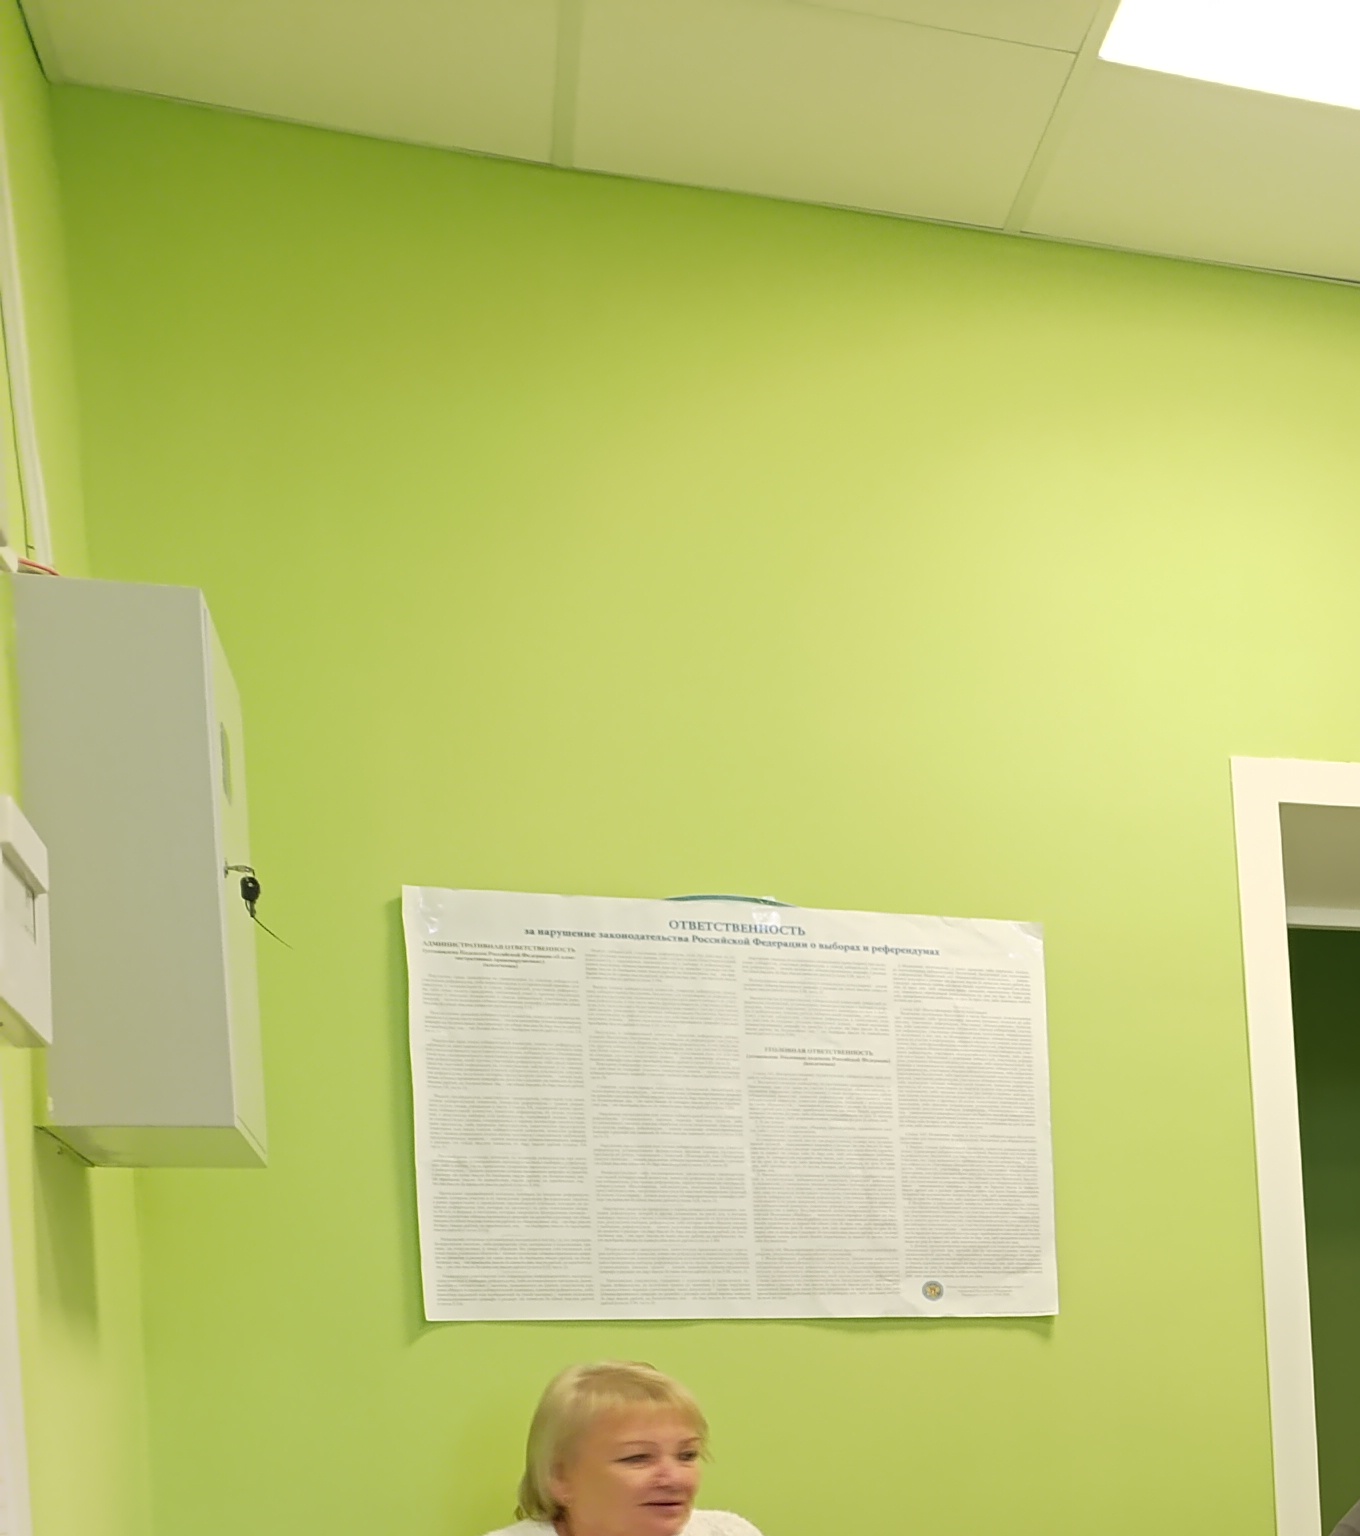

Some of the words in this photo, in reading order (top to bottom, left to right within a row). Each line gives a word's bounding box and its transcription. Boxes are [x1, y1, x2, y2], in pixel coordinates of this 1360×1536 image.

[669, 919, 806, 936] ОТВЕТСТВЕННОСТЬ
[524, 928, 535, 936] за
[537, 928, 597, 940] нарушение
[598, 932, 689, 943] законодательства
[692, 934, 750, 946] Российской
[752, 937, 808, 950] Федерации
[818, 941, 861, 952] выборах
[871, 945, 940, 957] референдумах
